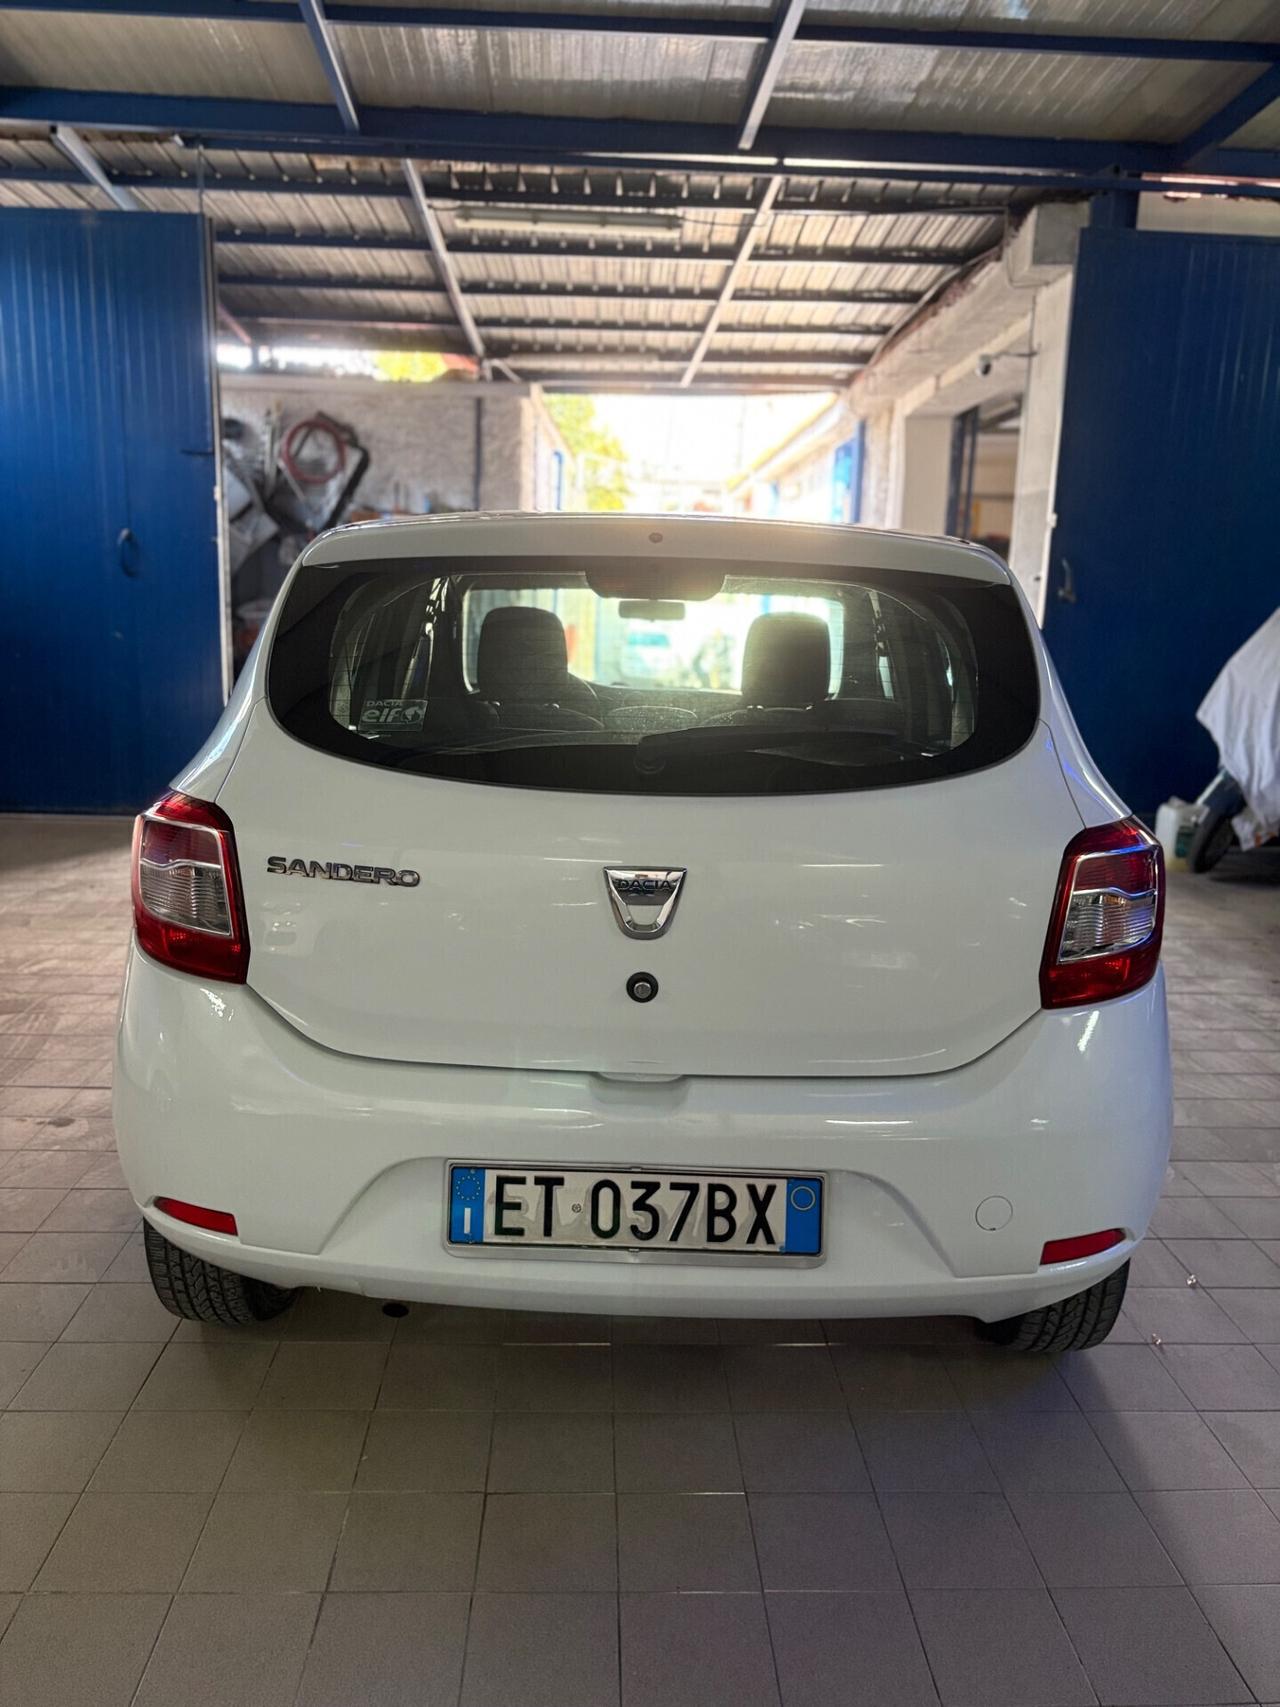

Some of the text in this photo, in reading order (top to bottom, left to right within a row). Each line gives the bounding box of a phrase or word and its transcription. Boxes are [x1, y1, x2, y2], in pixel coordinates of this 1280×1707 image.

[361, 708, 403, 722] elf
[267, 856, 420, 887] SANDERO
[618, 879, 673, 890] DACIA
[464, 1207, 471, 1234] I
[494, 1175, 777, 1245] ET 037BX
